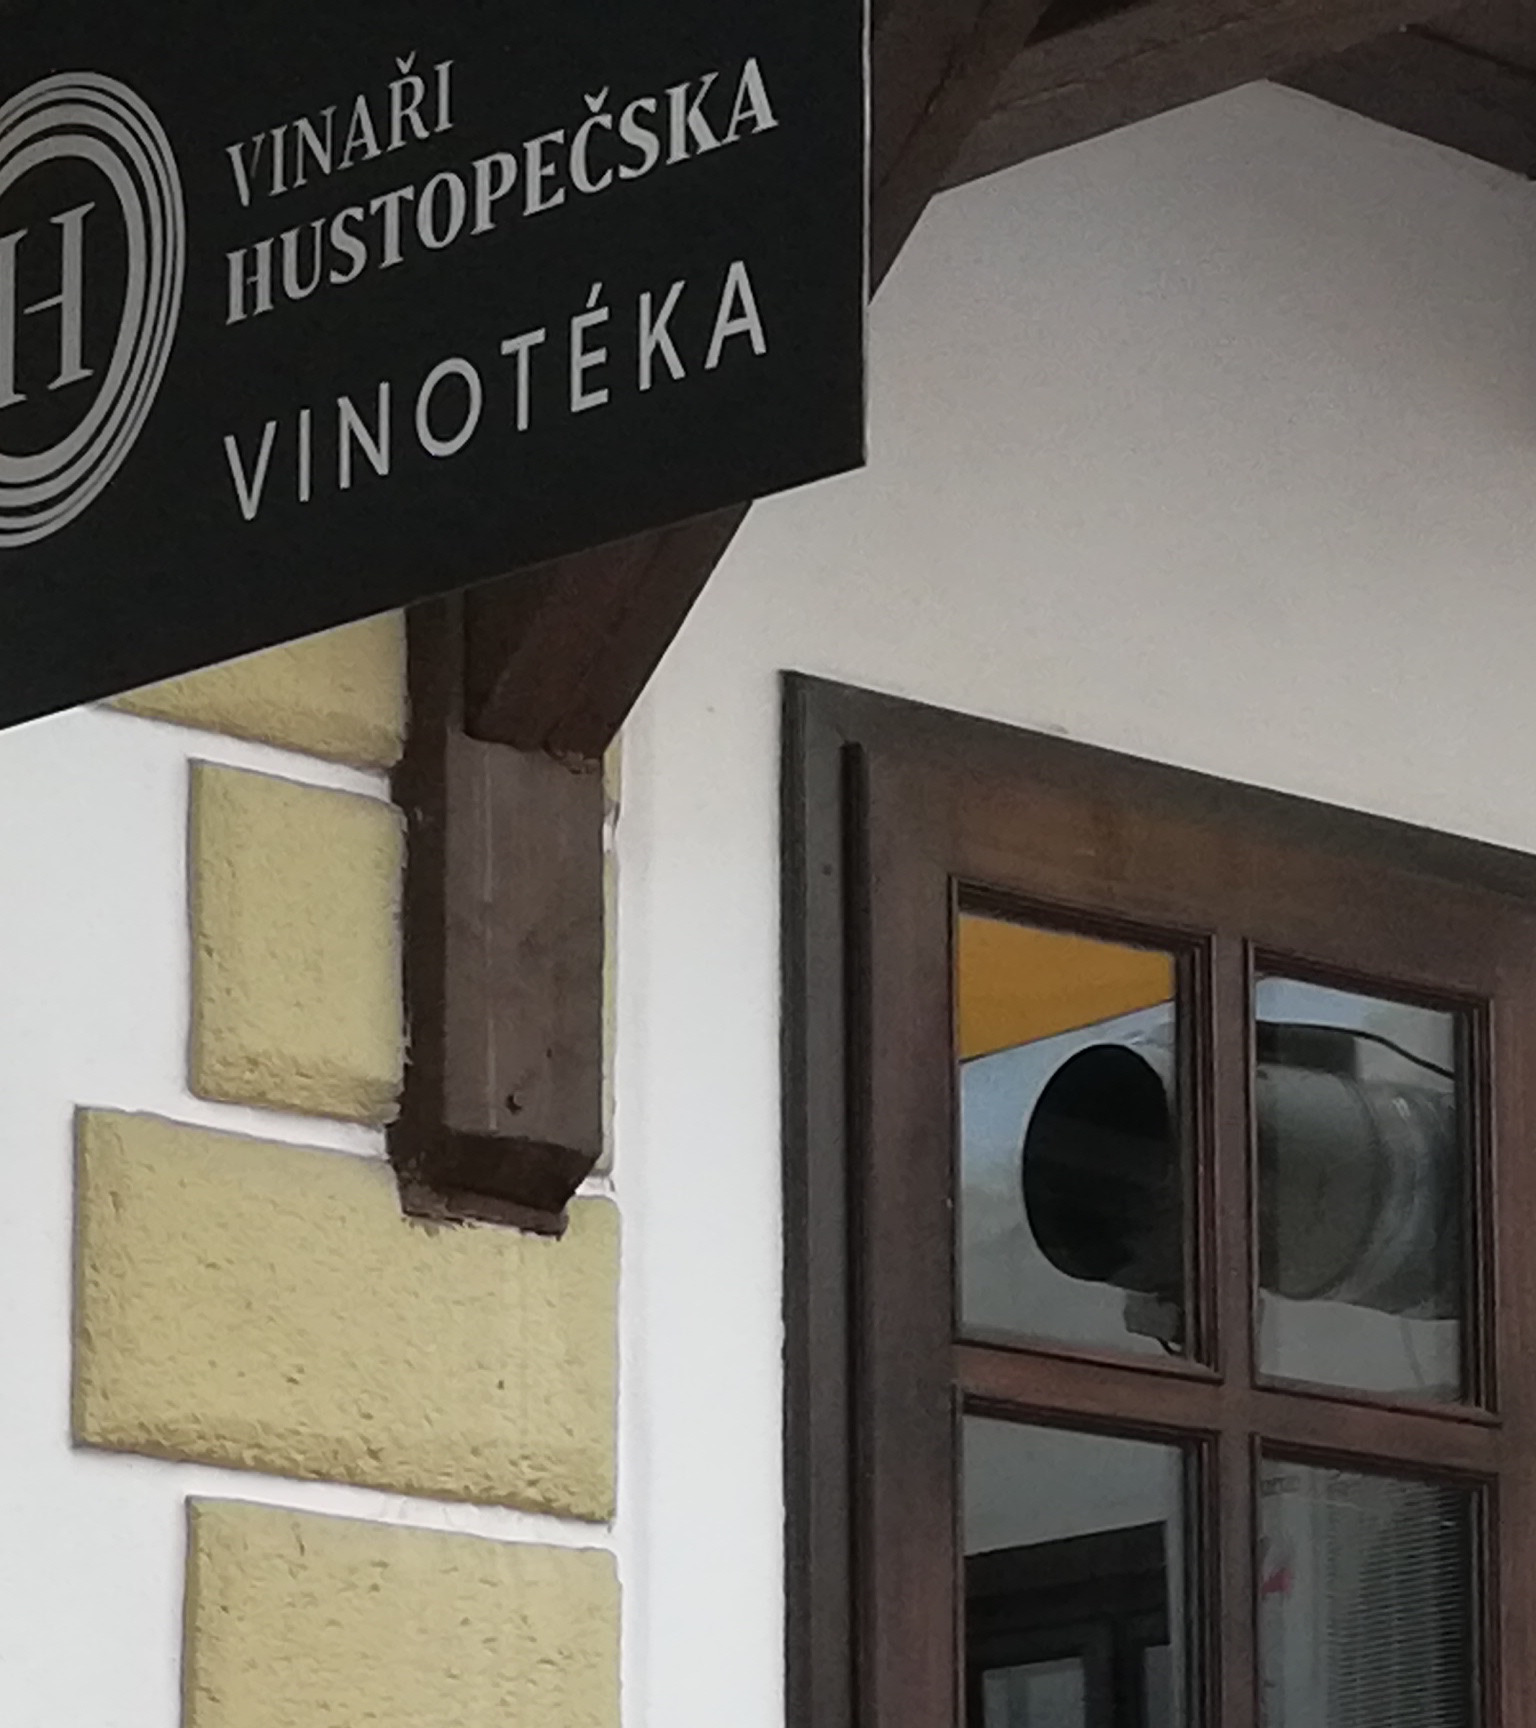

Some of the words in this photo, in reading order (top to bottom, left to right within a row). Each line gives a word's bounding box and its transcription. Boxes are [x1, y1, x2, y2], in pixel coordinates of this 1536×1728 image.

[225, 57, 779, 325] HUSTOPEČSKA
[226, 51, 454, 207] VINAŘI
[223, 261, 768, 521] VINOTÉKA
